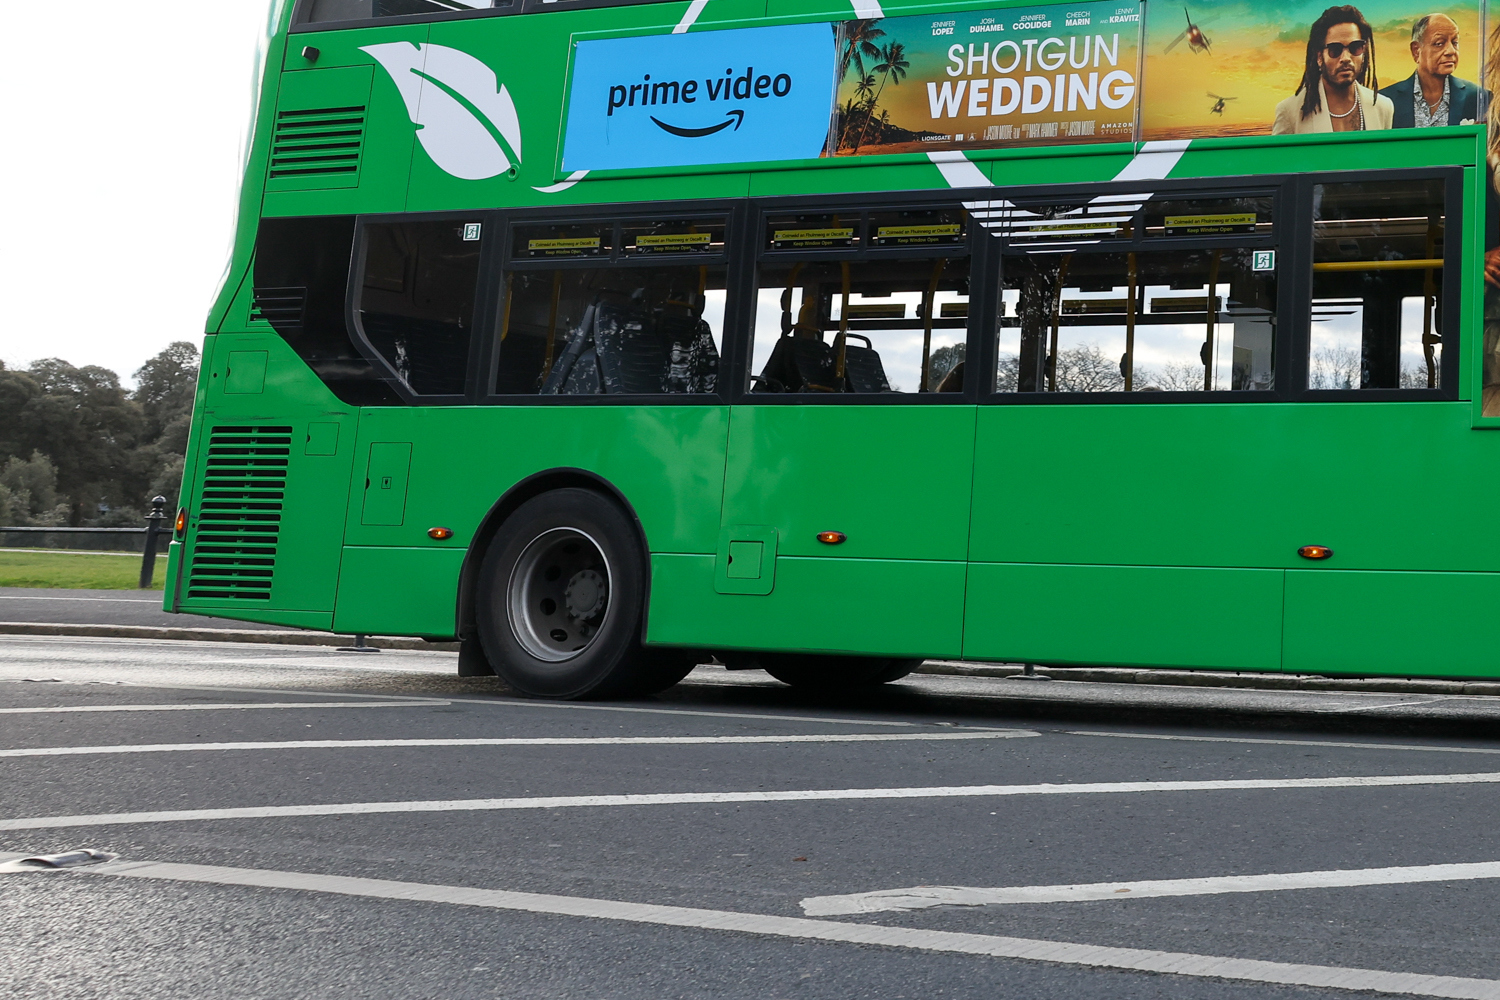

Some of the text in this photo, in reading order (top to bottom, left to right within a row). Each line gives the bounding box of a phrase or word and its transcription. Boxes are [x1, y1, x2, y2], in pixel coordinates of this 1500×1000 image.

[1065, 18, 1090, 26] MARIN
[1109, 14, 1139, 23] KRAVITZ
[970, 24, 1004, 33] DUHAMEL
[1012, 20, 1052, 30] COOLIDGE
[932, 28, 954, 36] LOPEZ
[946, 33, 1119, 76] SHOTGUN
[607, 67, 792, 116] prime video
[926, 70, 1135, 118] WEDDING
